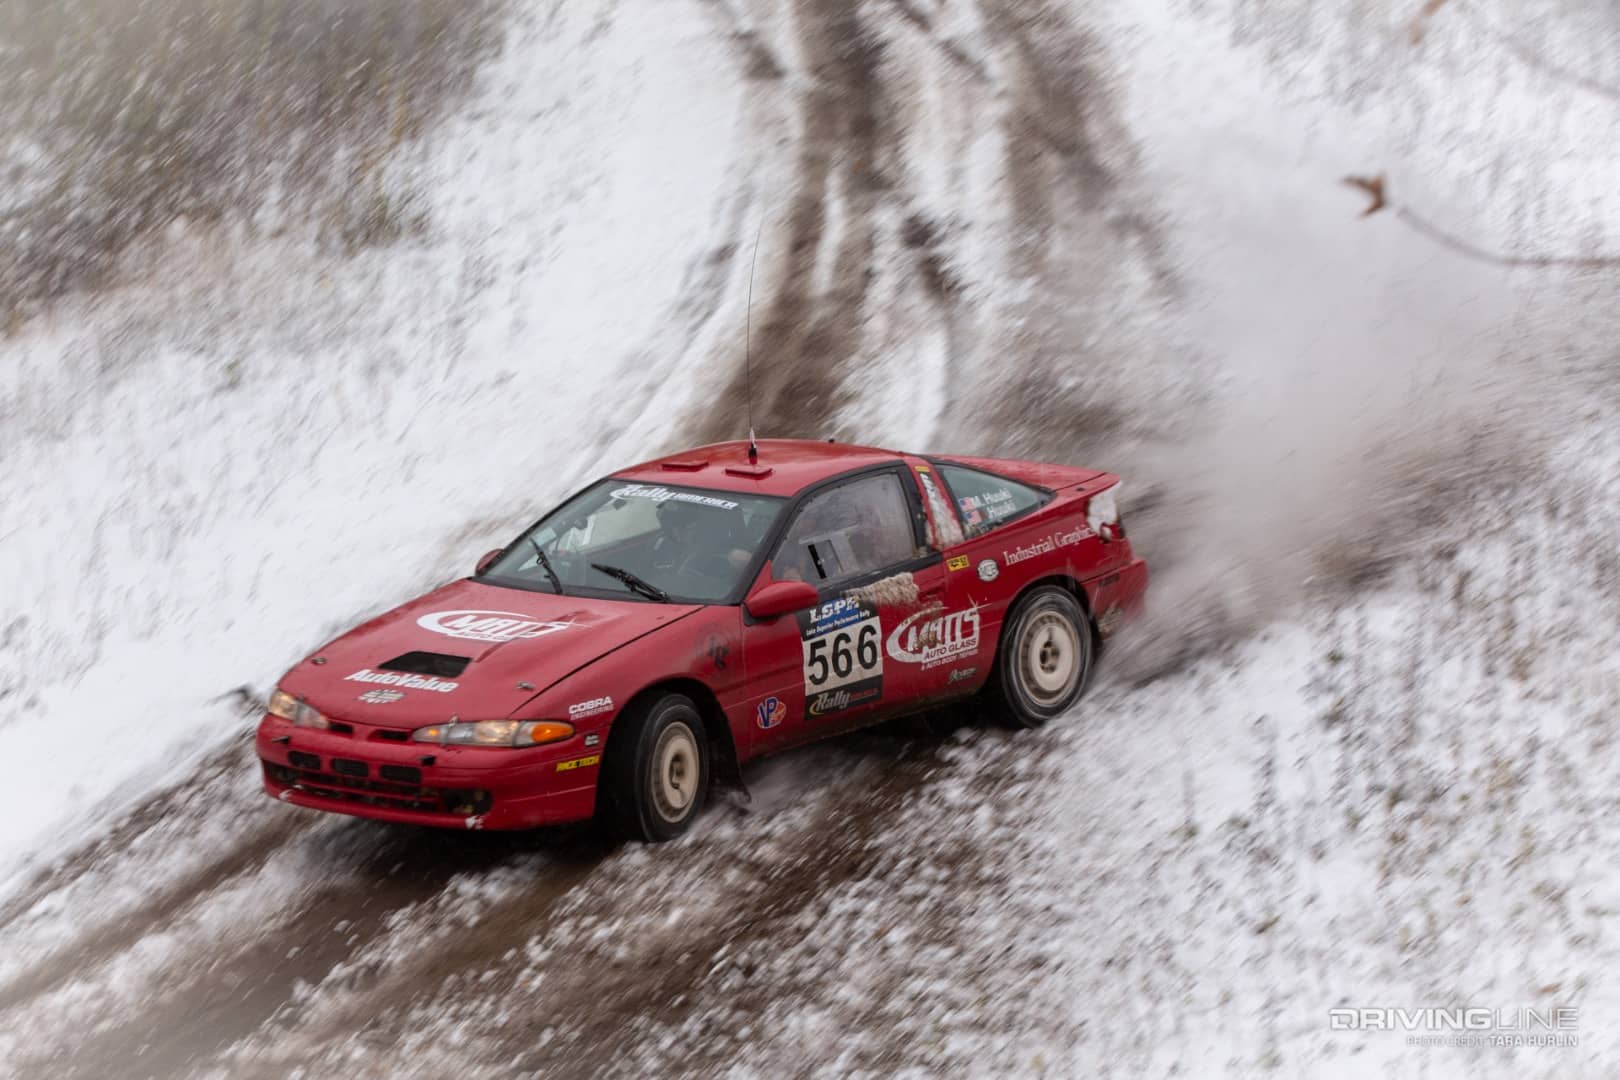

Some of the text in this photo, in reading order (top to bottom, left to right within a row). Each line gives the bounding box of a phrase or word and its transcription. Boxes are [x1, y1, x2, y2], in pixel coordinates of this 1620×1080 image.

[609, 484, 676, 503] Rally
[1003, 536, 1055, 566] Industrial
[807, 624, 878, 686] 566
[925, 638, 978, 660] AUTO GLASS
[343, 668, 460, 693] AutoValue
[568, 696, 613, 715] COBRA
[757, 696, 780, 729] VP
[812, 689, 851, 712] Rally
